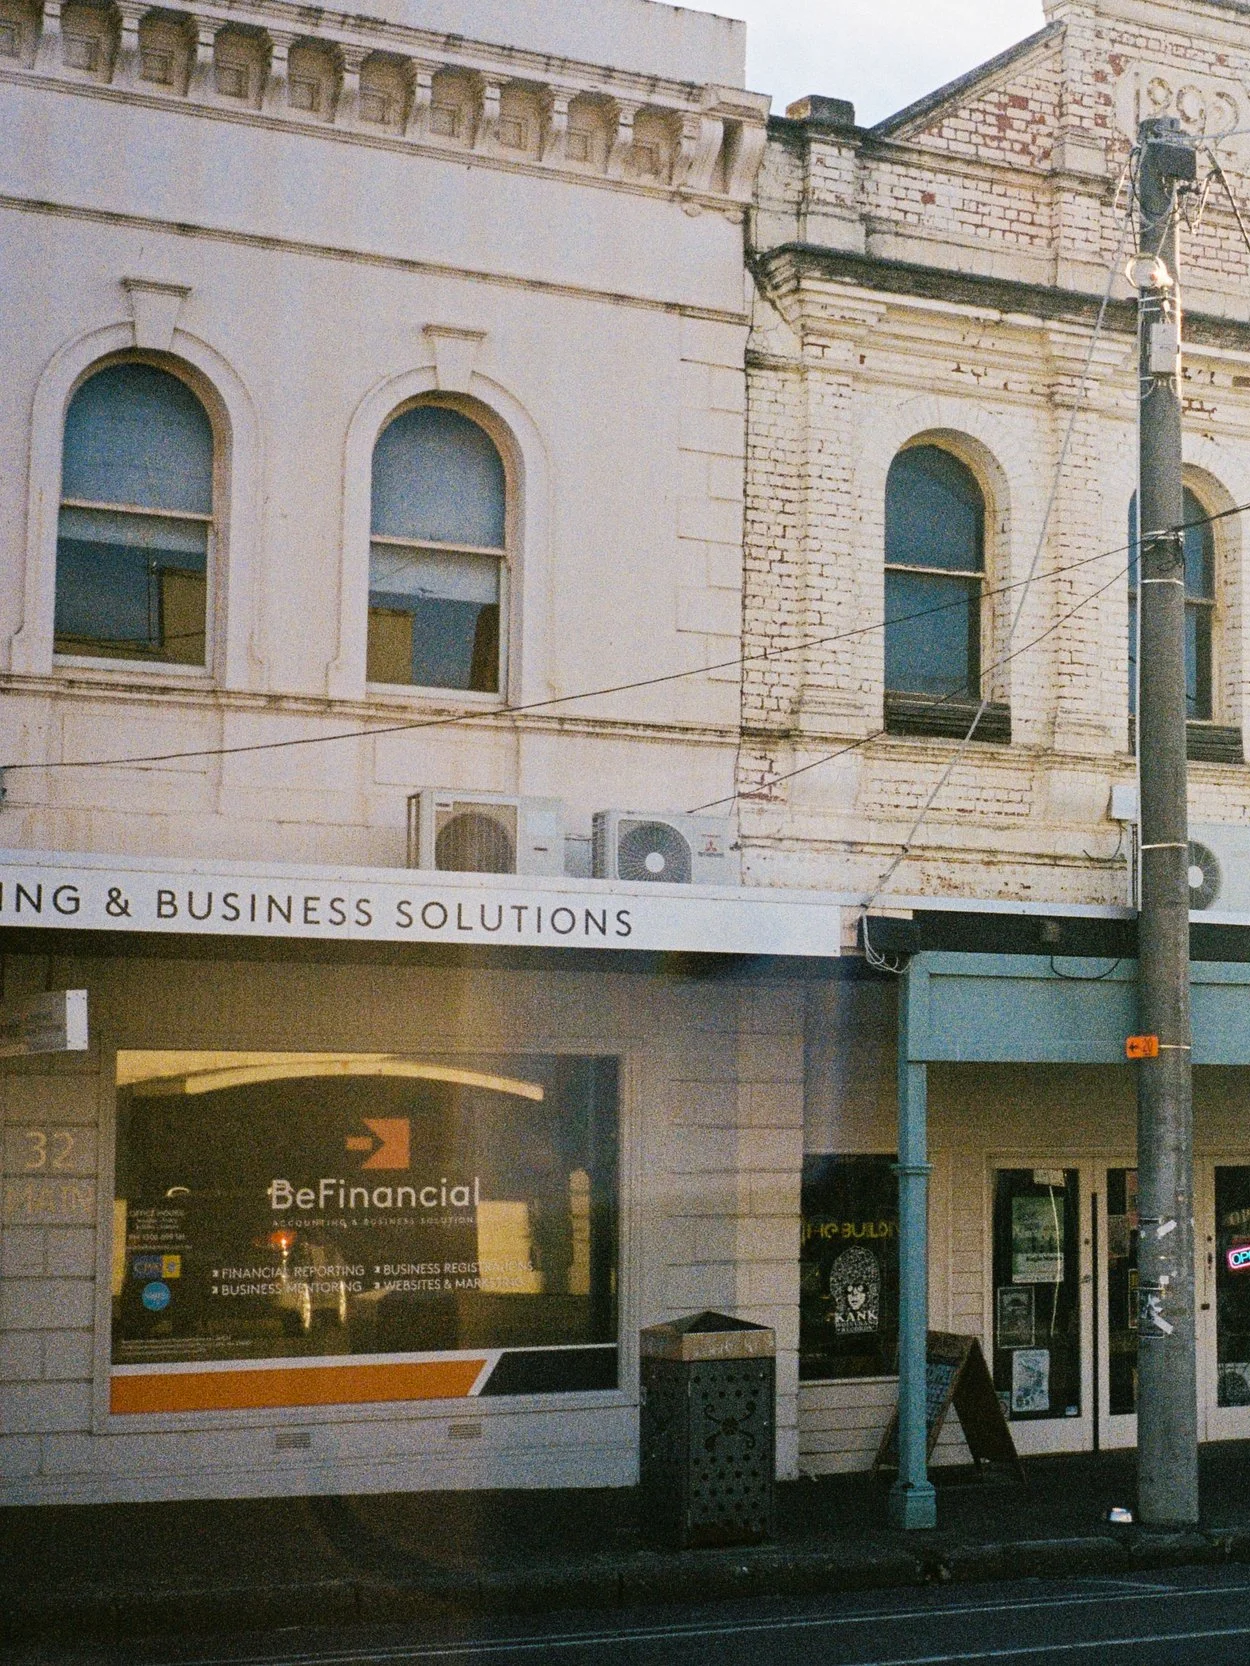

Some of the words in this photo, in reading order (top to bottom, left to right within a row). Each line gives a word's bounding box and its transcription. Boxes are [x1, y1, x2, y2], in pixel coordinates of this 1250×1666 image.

[106, 887, 133, 917] &
[157, 889, 373, 927] BUSINESS
[396, 900, 634, 937] SOLUTIONS
[25, 1131, 75, 1169] 32
[271, 1176, 480, 1209] BeFinancial
[221, 1266, 291, 1279] FINANCIAL
[294, 1265, 365, 1277] REPORTING
[383, 1263, 440, 1275] BUSINESS
[221, 1283, 282, 1296] BUSINESS
[286, 1281, 363, 1295] MENTORING
[383, 1278, 441, 1291] WEBSITES
[443, 1279, 452, 1289] &
